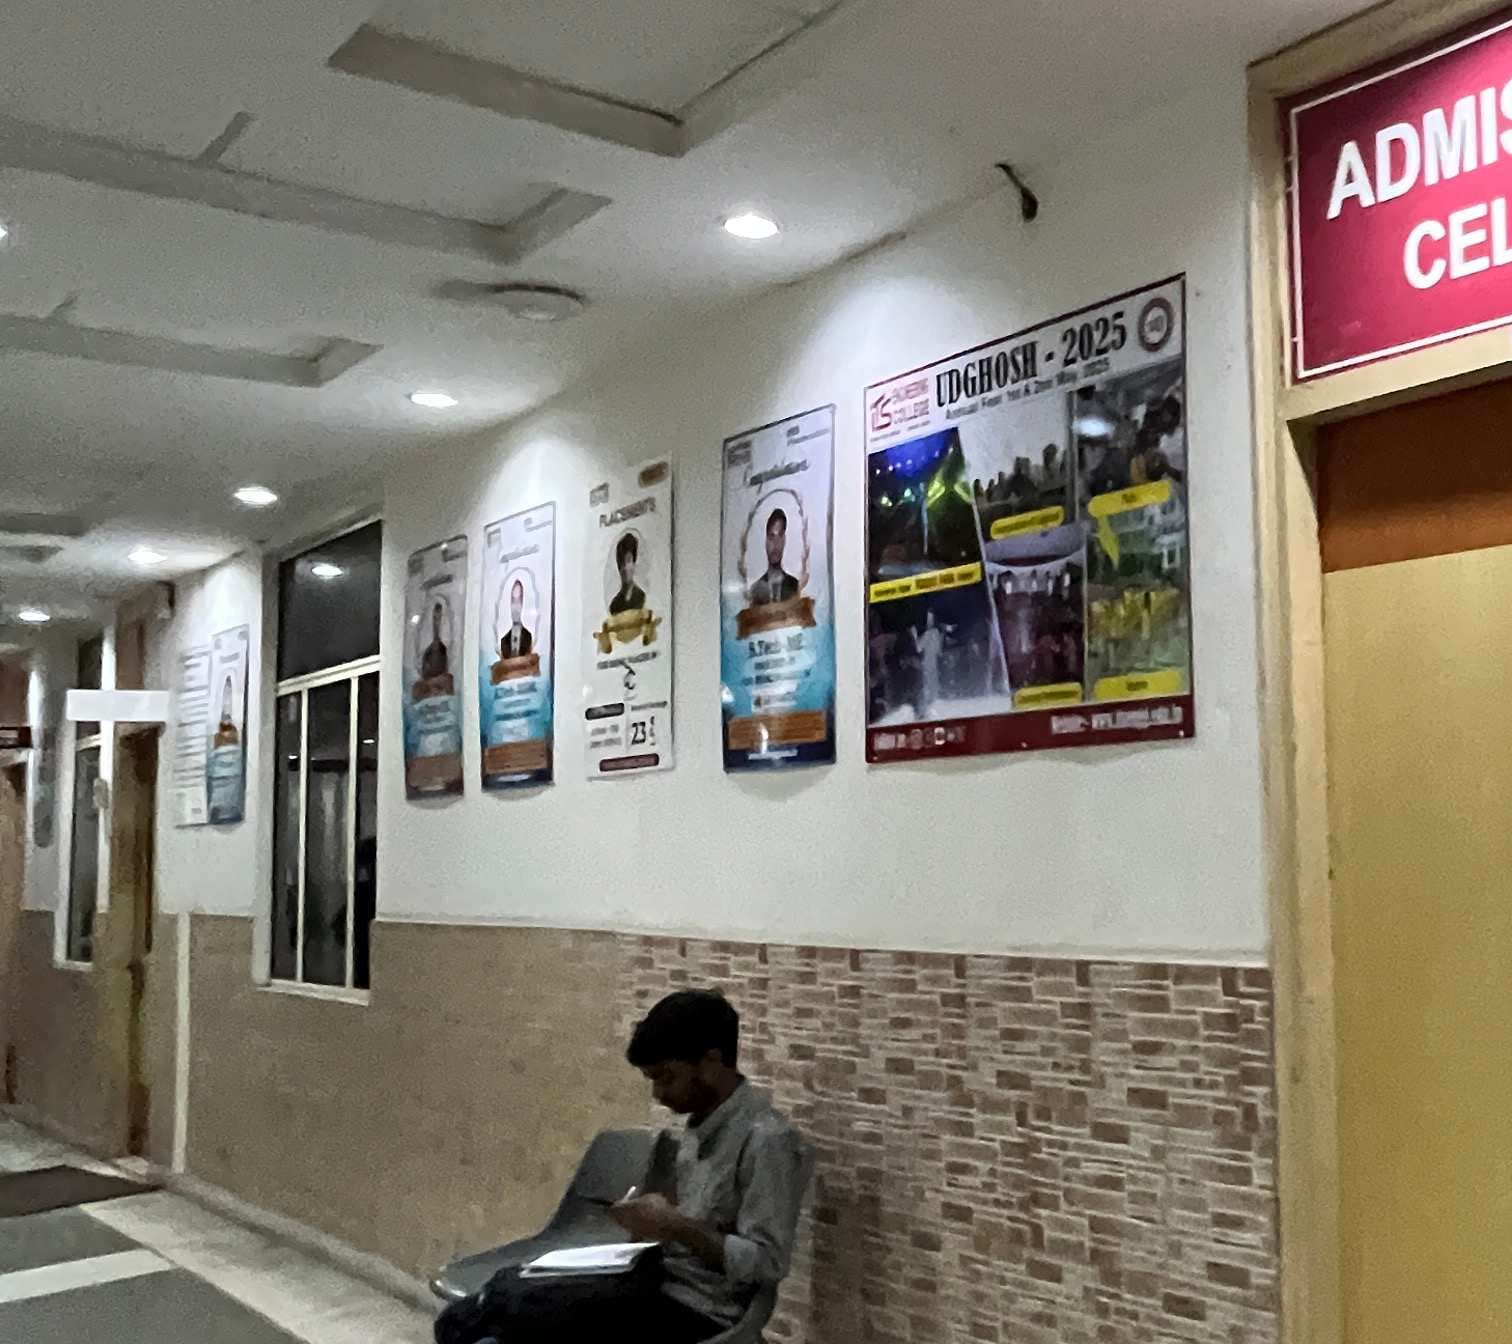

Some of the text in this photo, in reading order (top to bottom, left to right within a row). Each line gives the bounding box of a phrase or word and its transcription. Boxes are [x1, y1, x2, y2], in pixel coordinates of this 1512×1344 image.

[936, 340, 1039, 408] UDGHOSH
[1062, 311, 1127, 368] 2025
[631, 721, 647, 745] 23
